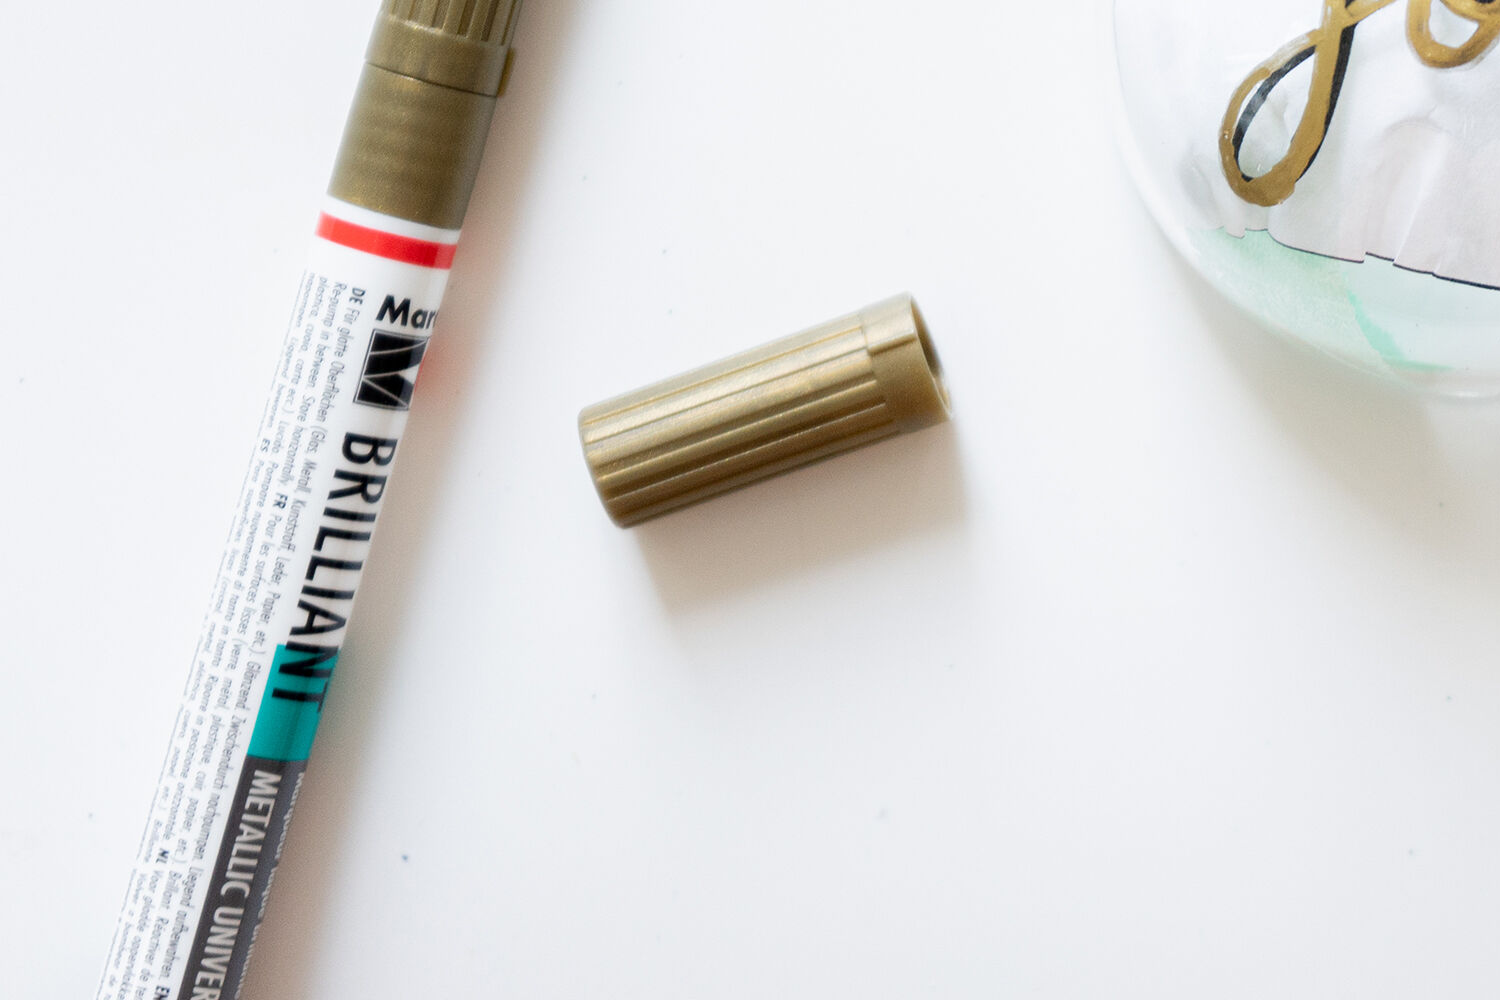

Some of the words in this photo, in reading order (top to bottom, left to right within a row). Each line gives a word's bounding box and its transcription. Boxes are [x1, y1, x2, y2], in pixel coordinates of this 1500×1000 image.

[343, 307, 361, 325] Für
[348, 287, 366, 306] DE
[334, 326, 354, 358] glatte
[316, 361, 345, 423] Oberflächen
[272, 432, 398, 712] BRILLIANT
[213, 714, 247, 790] Zwischendurch
[221, 770, 282, 898] METALLIC
[179, 866, 204, 909] Liegend
